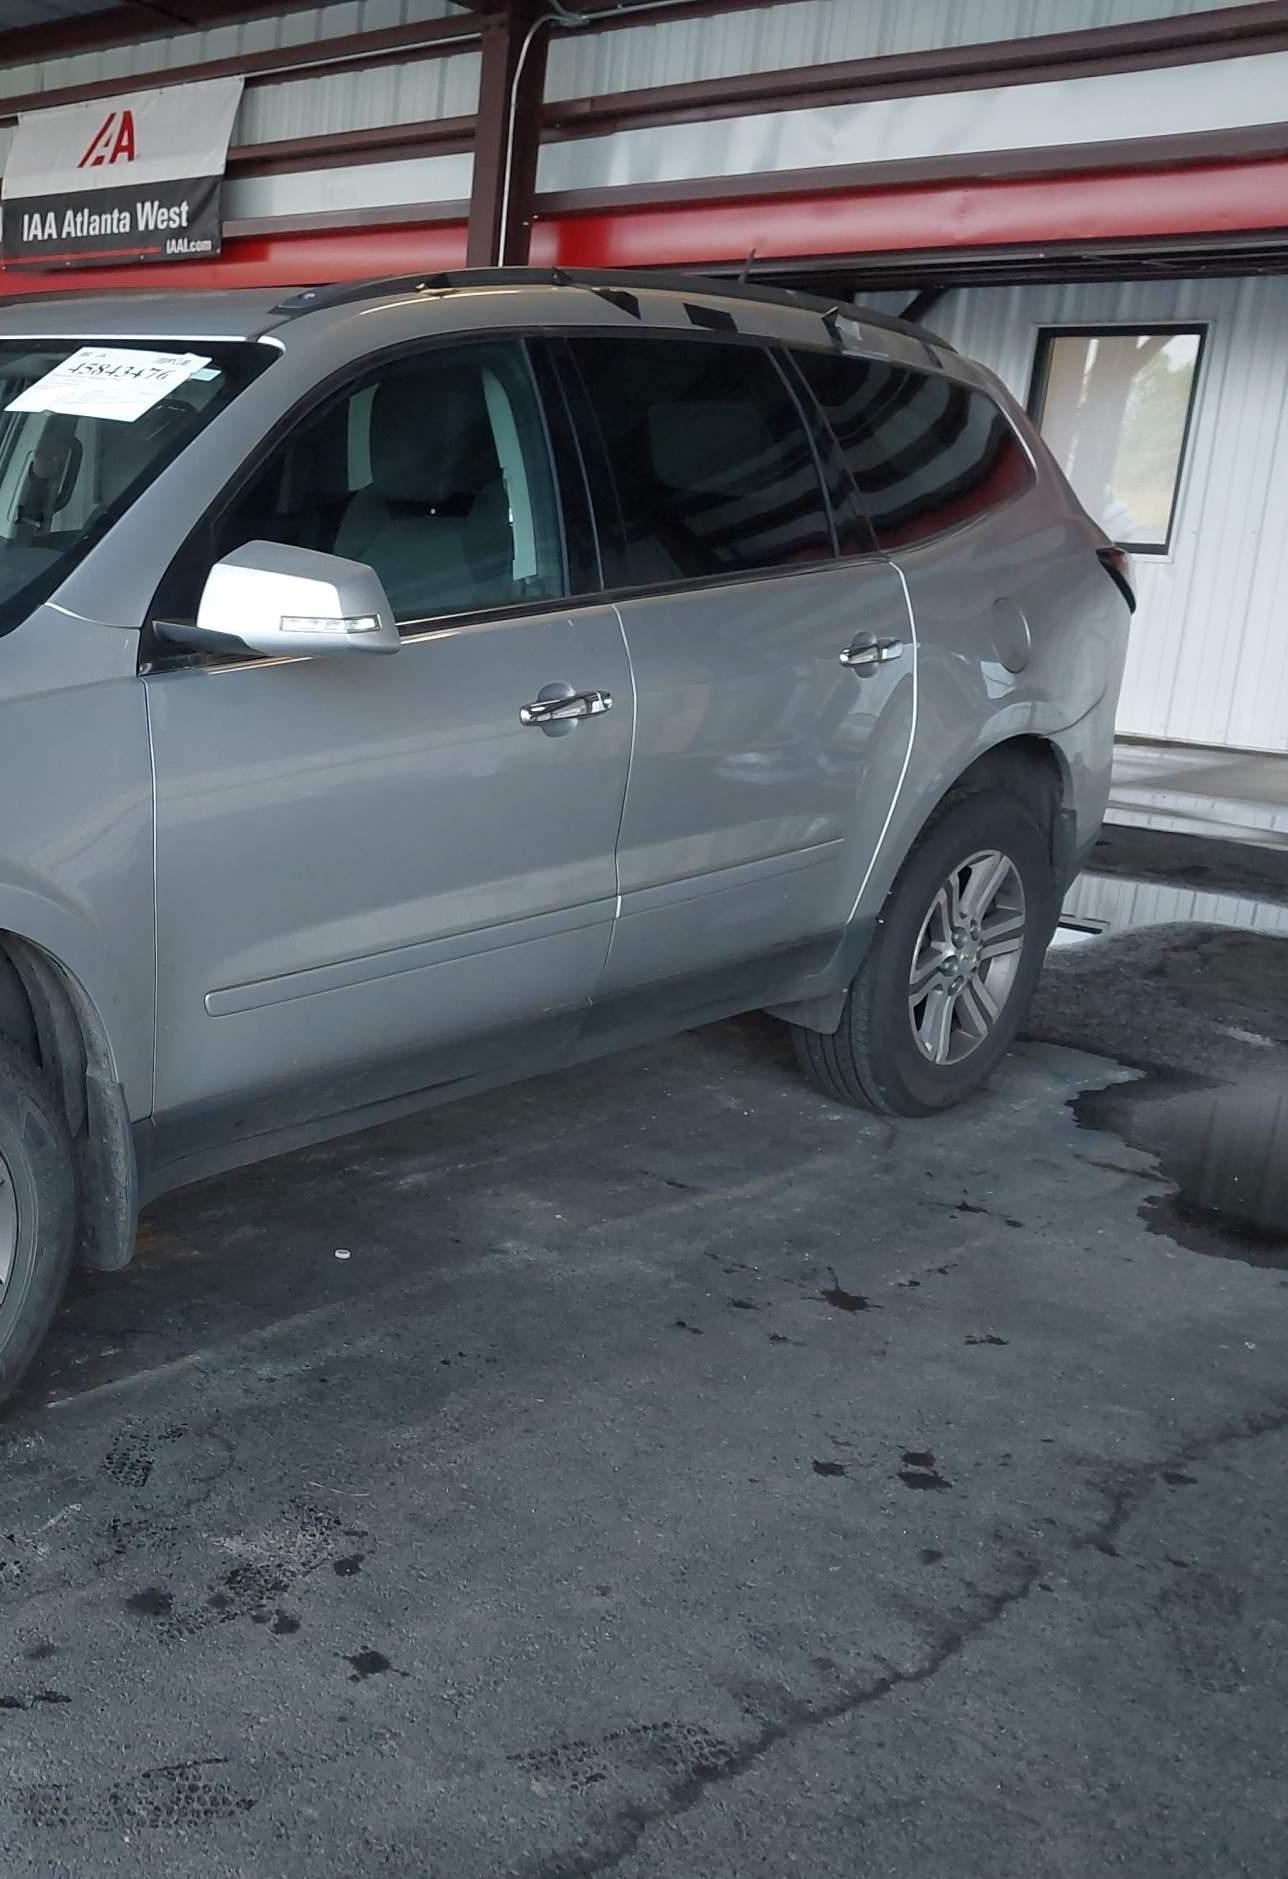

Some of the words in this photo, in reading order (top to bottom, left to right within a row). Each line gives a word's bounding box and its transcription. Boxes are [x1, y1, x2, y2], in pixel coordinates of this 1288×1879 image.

[22, 211, 58, 242] IAA
[62, 206, 131, 238] Atlanta
[136, 199, 189, 230] West
